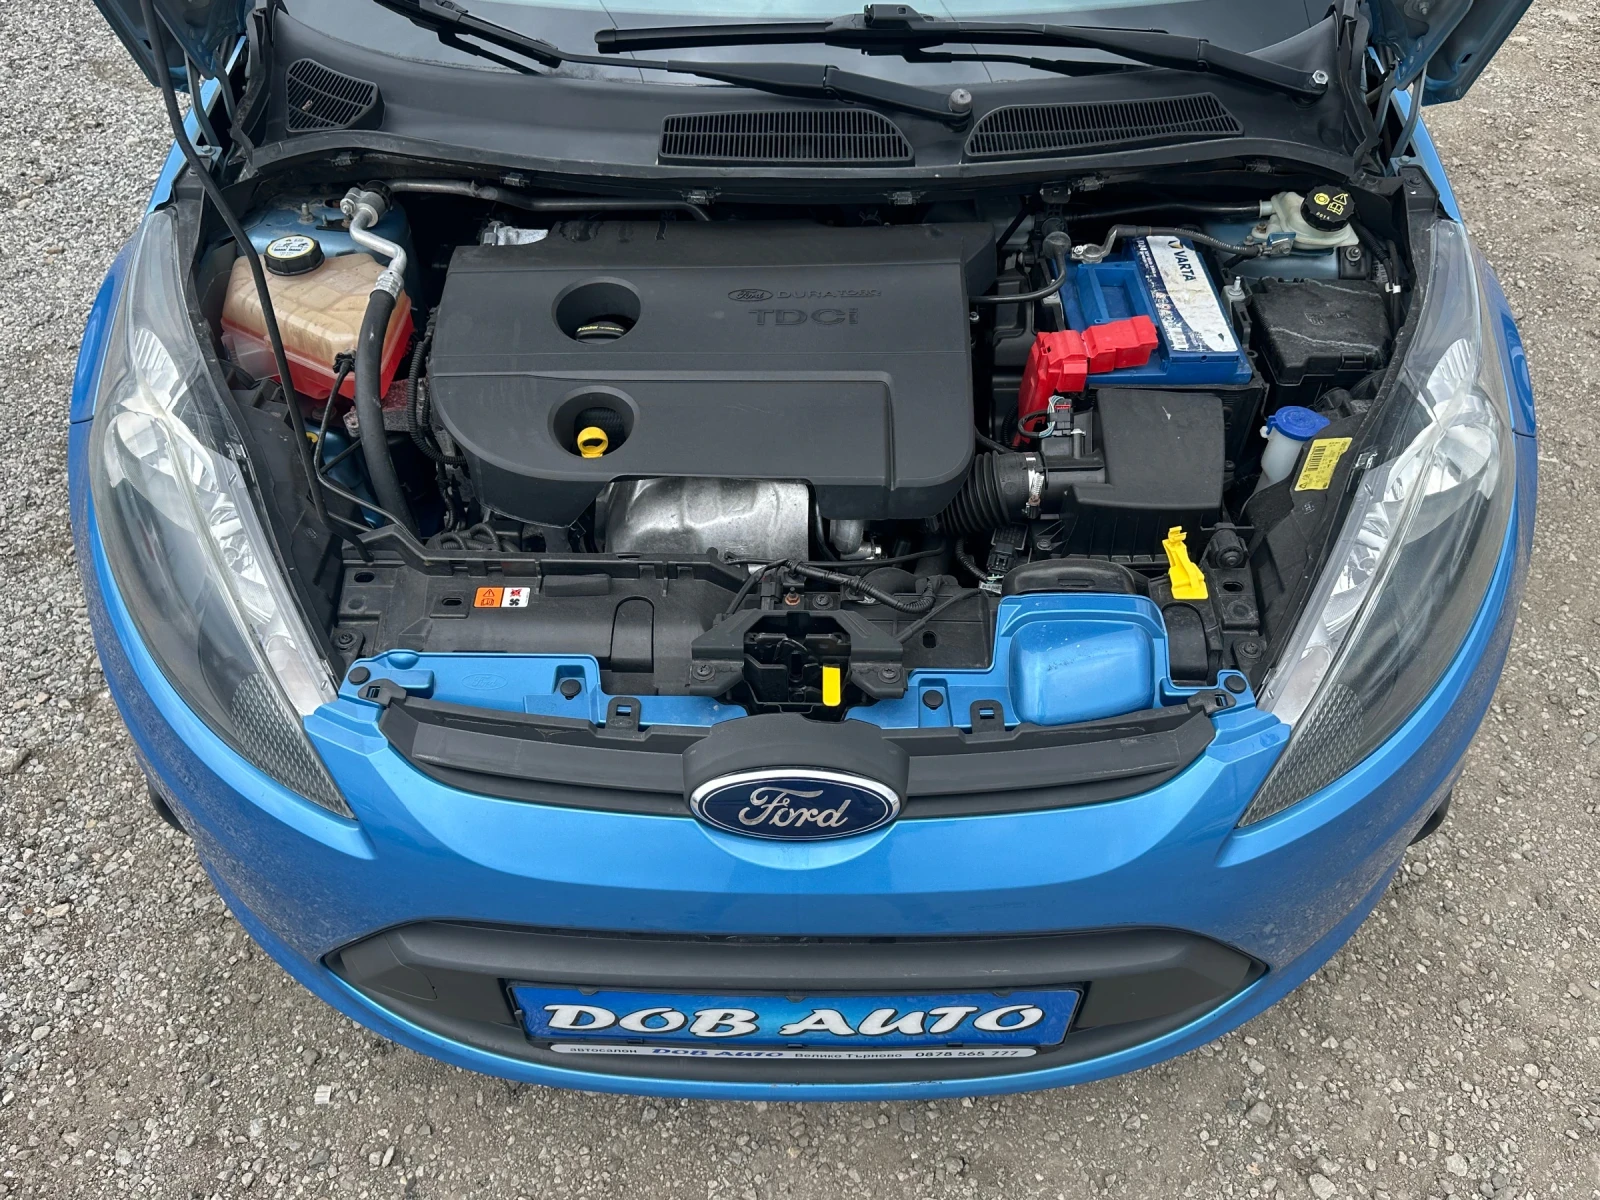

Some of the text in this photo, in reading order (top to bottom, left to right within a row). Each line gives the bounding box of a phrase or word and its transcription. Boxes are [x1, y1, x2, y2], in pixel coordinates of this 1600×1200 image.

[1173, 250, 1197, 282] VARTA
[748, 307, 859, 326] TDCi
[738, 786, 852, 828] Ford
[543, 1003, 1046, 1038] DOB AUTO
[652, 1048, 709, 1056] DOB
[714, 1050, 784, 1058] AUTO
